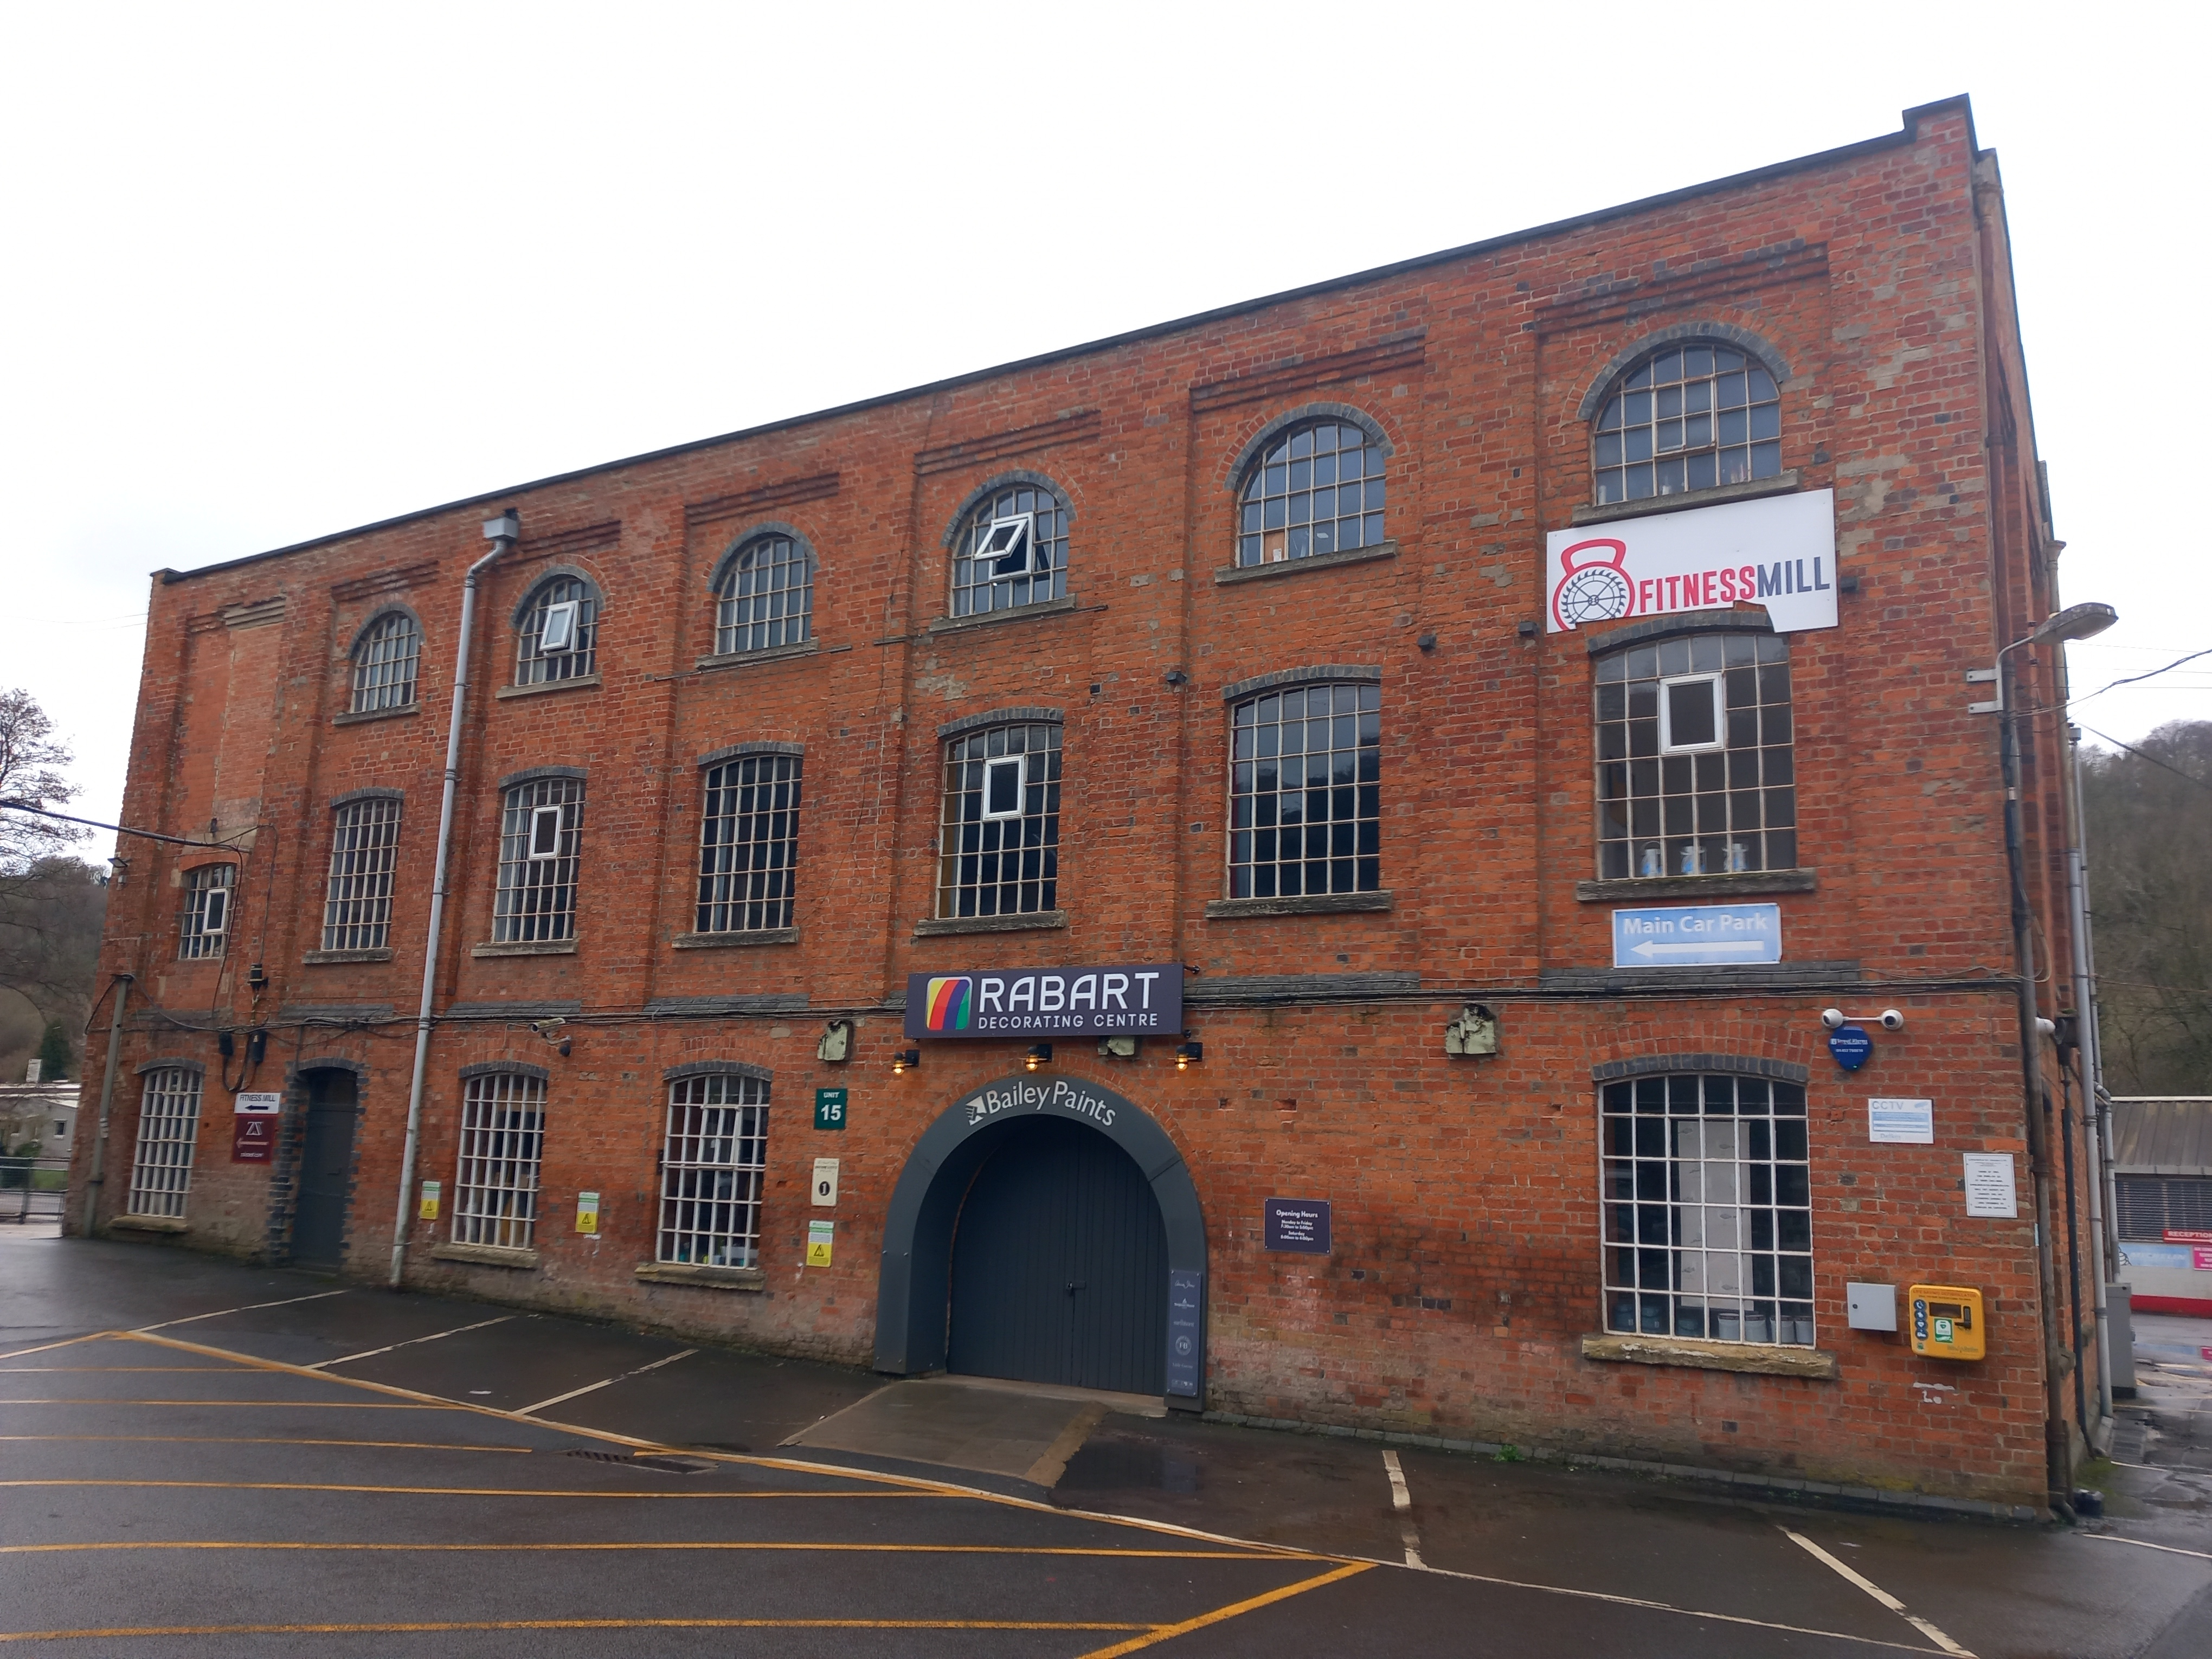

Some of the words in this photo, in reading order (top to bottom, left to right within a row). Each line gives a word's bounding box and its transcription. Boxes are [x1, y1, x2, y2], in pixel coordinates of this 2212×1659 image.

[1623, 916, 1675, 934] Main
[1680, 915, 1715, 933] Car
[1719, 912, 1769, 930] Park
[979, 972, 1160, 1013] RABART
[979, 1014, 1084, 1029] DECORATING
[1094, 1013, 1158, 1027] CENTRE
[986, 1081, 1051, 1114] Bailey
[1052, 1081, 1116, 1126] Paints
[1872, 1101, 1904, 1110] CCTV
[820, 1104, 842, 1121] 15
[821, 1183, 827, 1194] 1
[1276, 1210, 1300, 1218] Opening
